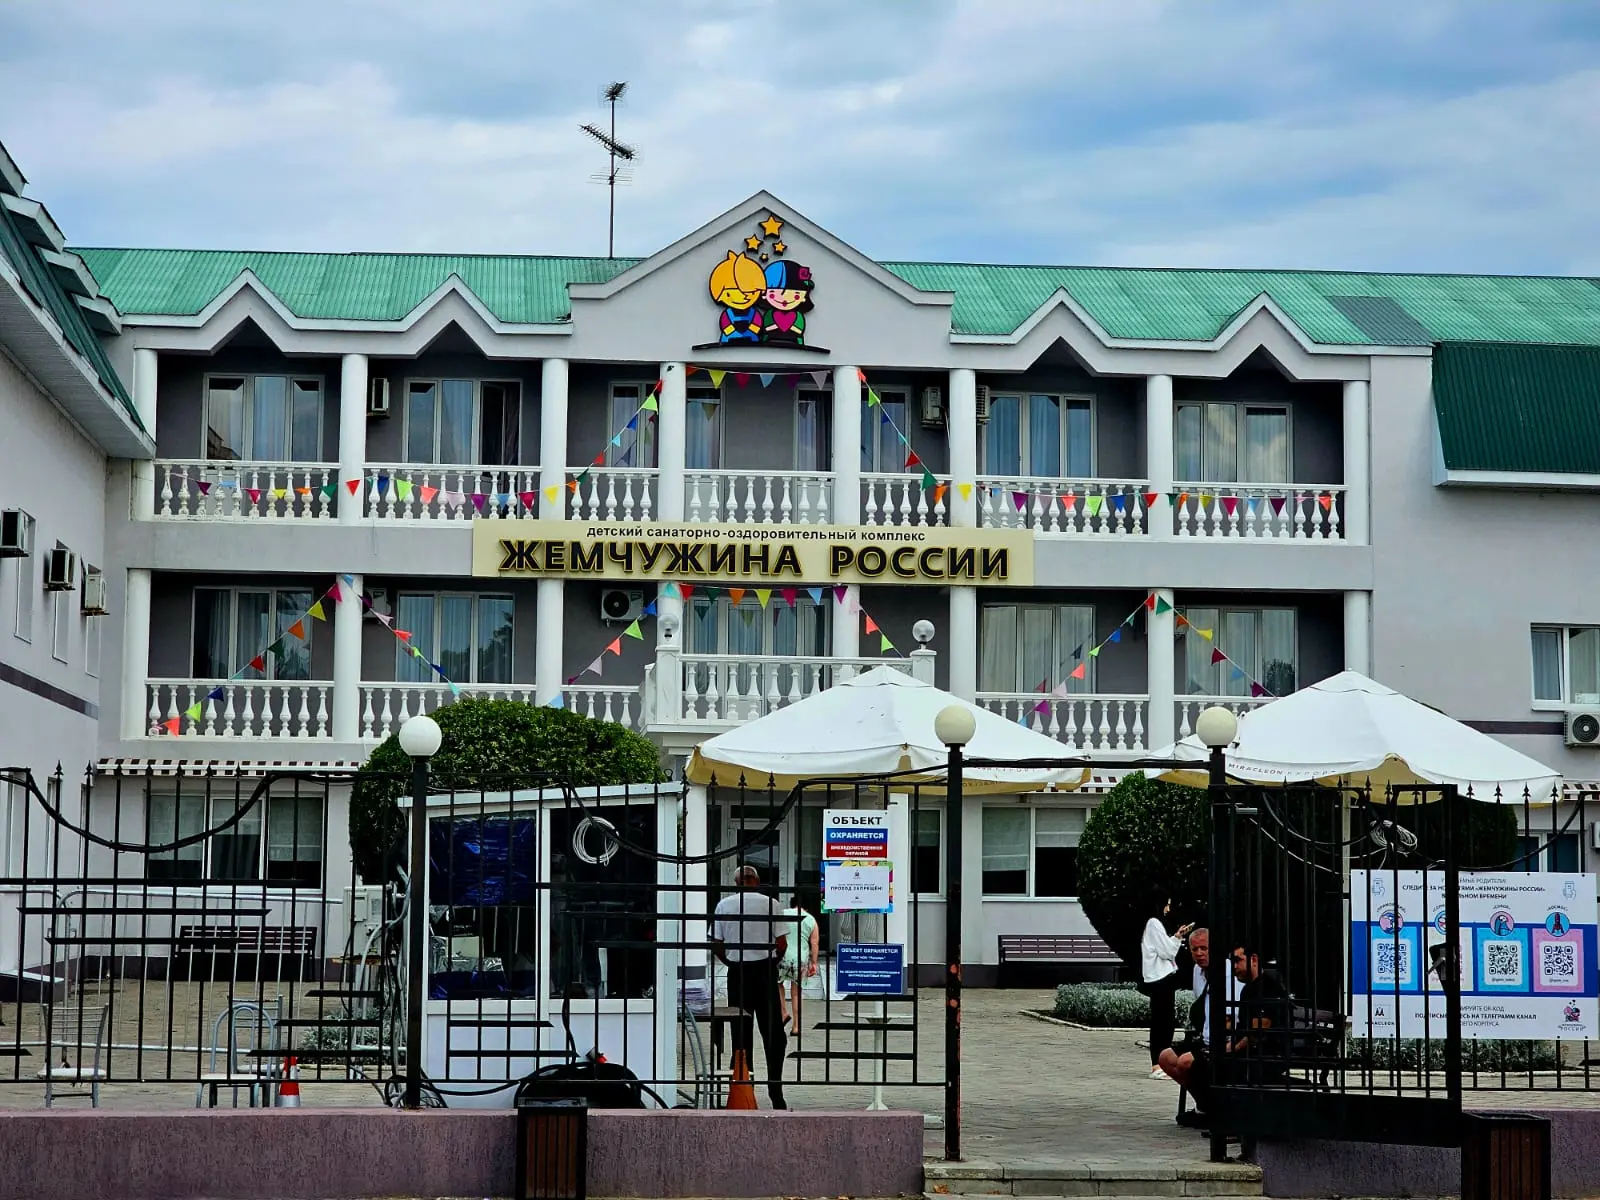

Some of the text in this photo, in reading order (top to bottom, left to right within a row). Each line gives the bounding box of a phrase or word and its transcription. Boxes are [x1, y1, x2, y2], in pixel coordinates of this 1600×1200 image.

[587, 525, 926, 541] детский санаторно-оздоровительный комплекс
[499, 539, 1010, 579] ЖЕМЧУЖИНА РОССИИ
[1228, 763, 1283, 775] MIRACLEON
[832, 816, 882, 825] ОБЪЕКТ
[830, 831, 884, 839] ОХРАНЯЕТСЯ
